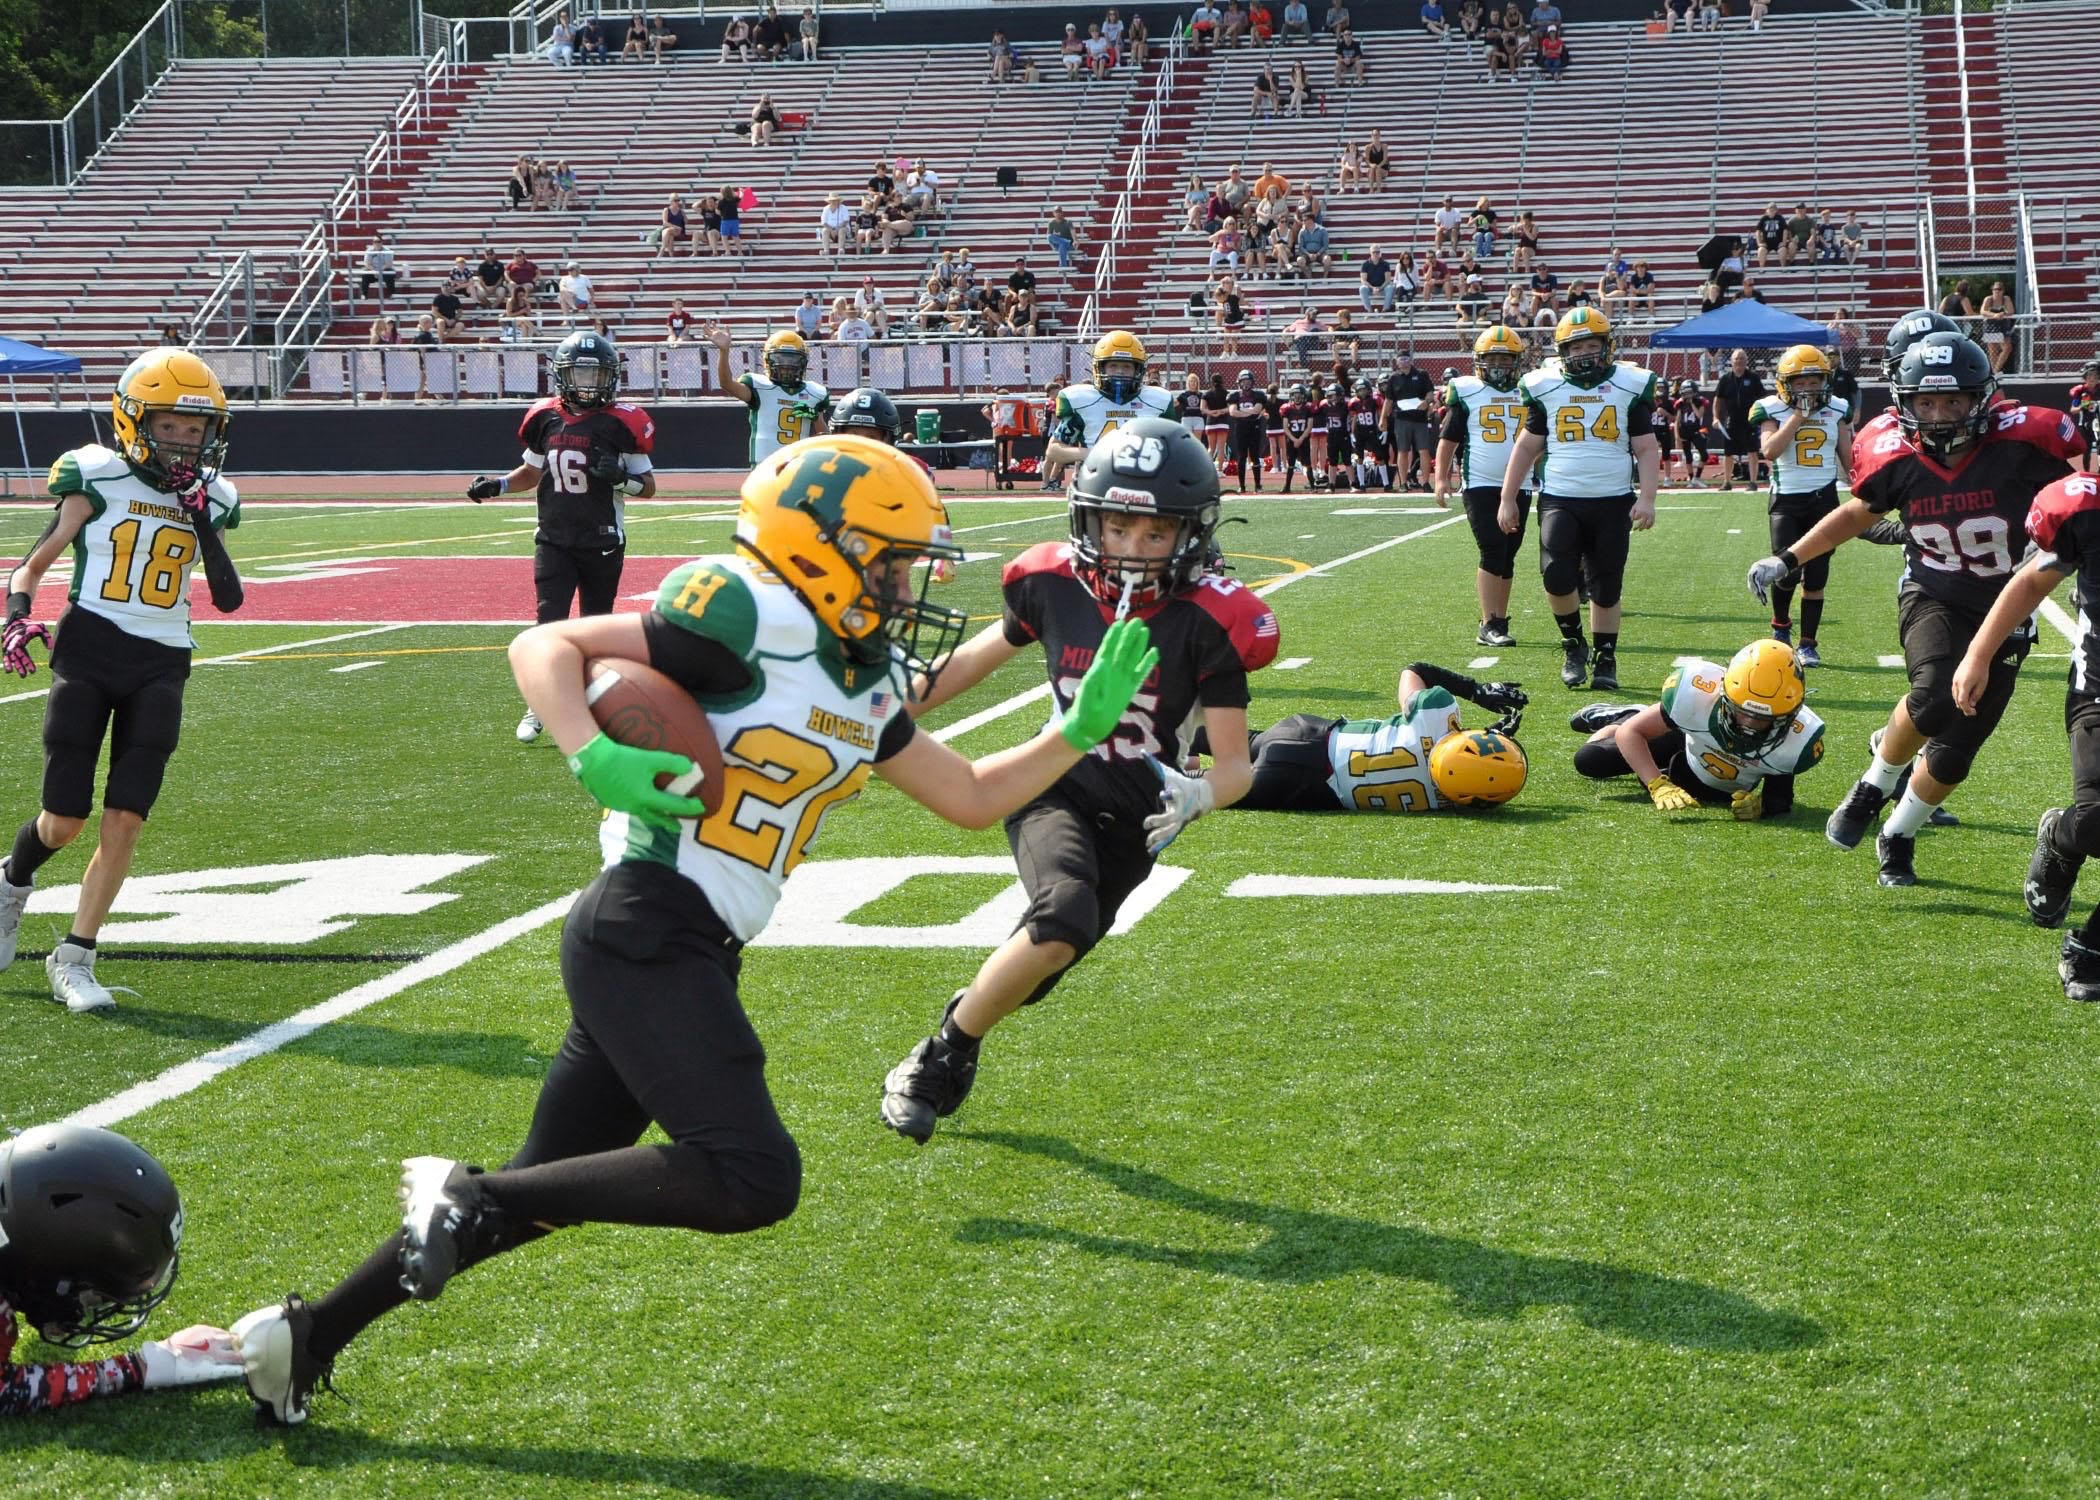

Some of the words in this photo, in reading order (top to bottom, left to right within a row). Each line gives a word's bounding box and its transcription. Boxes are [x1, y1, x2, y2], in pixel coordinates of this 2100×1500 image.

[1907, 316, 1932, 335] 10
[580, 338, 595, 348] 16
[1924, 345, 1952, 365] 99
[182, 396, 212, 404] Riddell
[857, 395, 871, 408] 3
[777, 407, 802, 445] 9
[1290, 419, 1306, 432] 37
[1328, 416, 1342, 428] 15
[1479, 405, 1529, 443] 57
[1556, 405, 1620, 443] 64
[1684, 411, 1696, 423] 14
[1116, 436, 1162, 472] 25
[1795, 428, 1828, 467] 2
[548, 449, 589, 494] 16
[777, 449, 871, 526] H
[1111, 490, 1150, 504] Riddell
[1908, 489, 1996, 517] MILFORD
[1910, 515, 2012, 577] 99
[101, 518, 197, 609] 18
[672, 569, 727, 619] H
[844, 668, 855, 688] H
[806, 705, 875, 751] HOWELL
